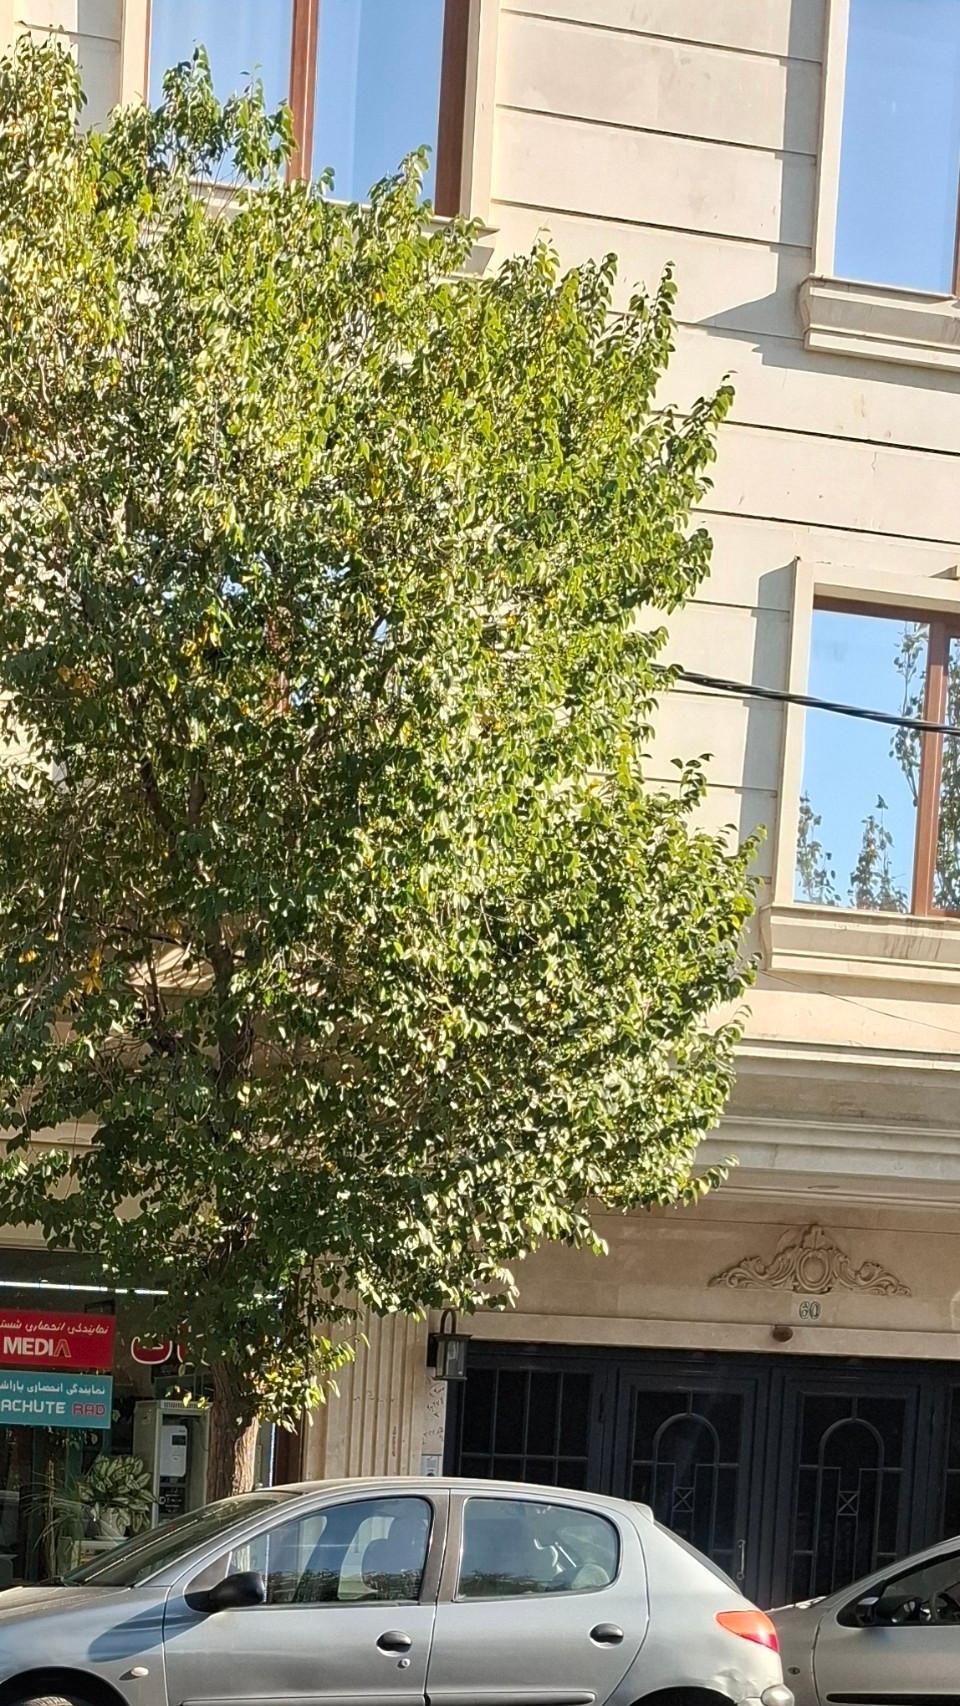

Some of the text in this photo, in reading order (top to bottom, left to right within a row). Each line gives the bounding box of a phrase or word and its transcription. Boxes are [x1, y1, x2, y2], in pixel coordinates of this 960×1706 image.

[799, 1300, 821, 1320] 60
[25, 1320, 65, 1333] انحصاری
[3, 1336, 72, 1358] MEDIA
[27, 1382, 63, 1394] انحصاری
[66, 1383, 105, 1396] نمایندگی
[72, 1403, 106, 1416] RAD
